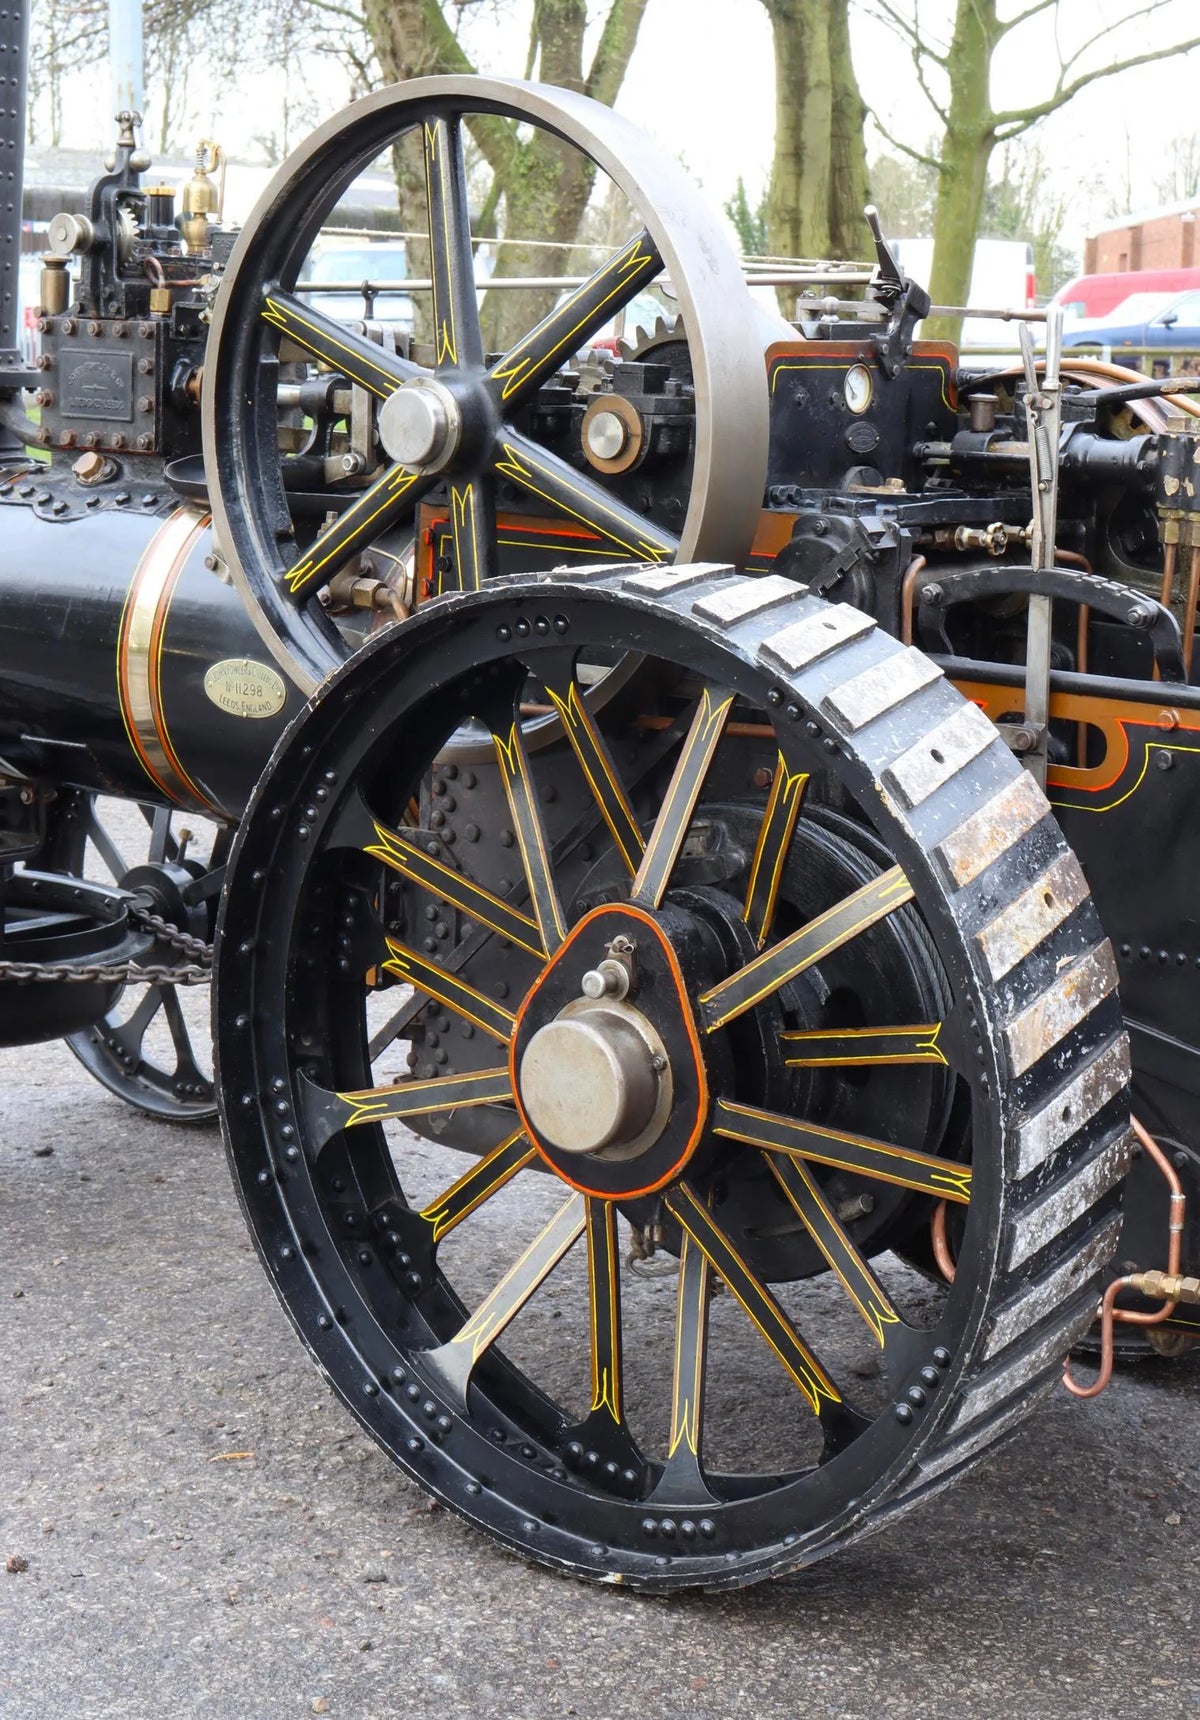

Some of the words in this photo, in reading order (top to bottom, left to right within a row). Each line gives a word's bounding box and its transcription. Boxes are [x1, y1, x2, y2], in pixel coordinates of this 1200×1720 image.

[235, 682, 263, 697] 11298
[219, 693, 239, 711] LEEDS
[241, 701, 272, 713] ENGLAND
